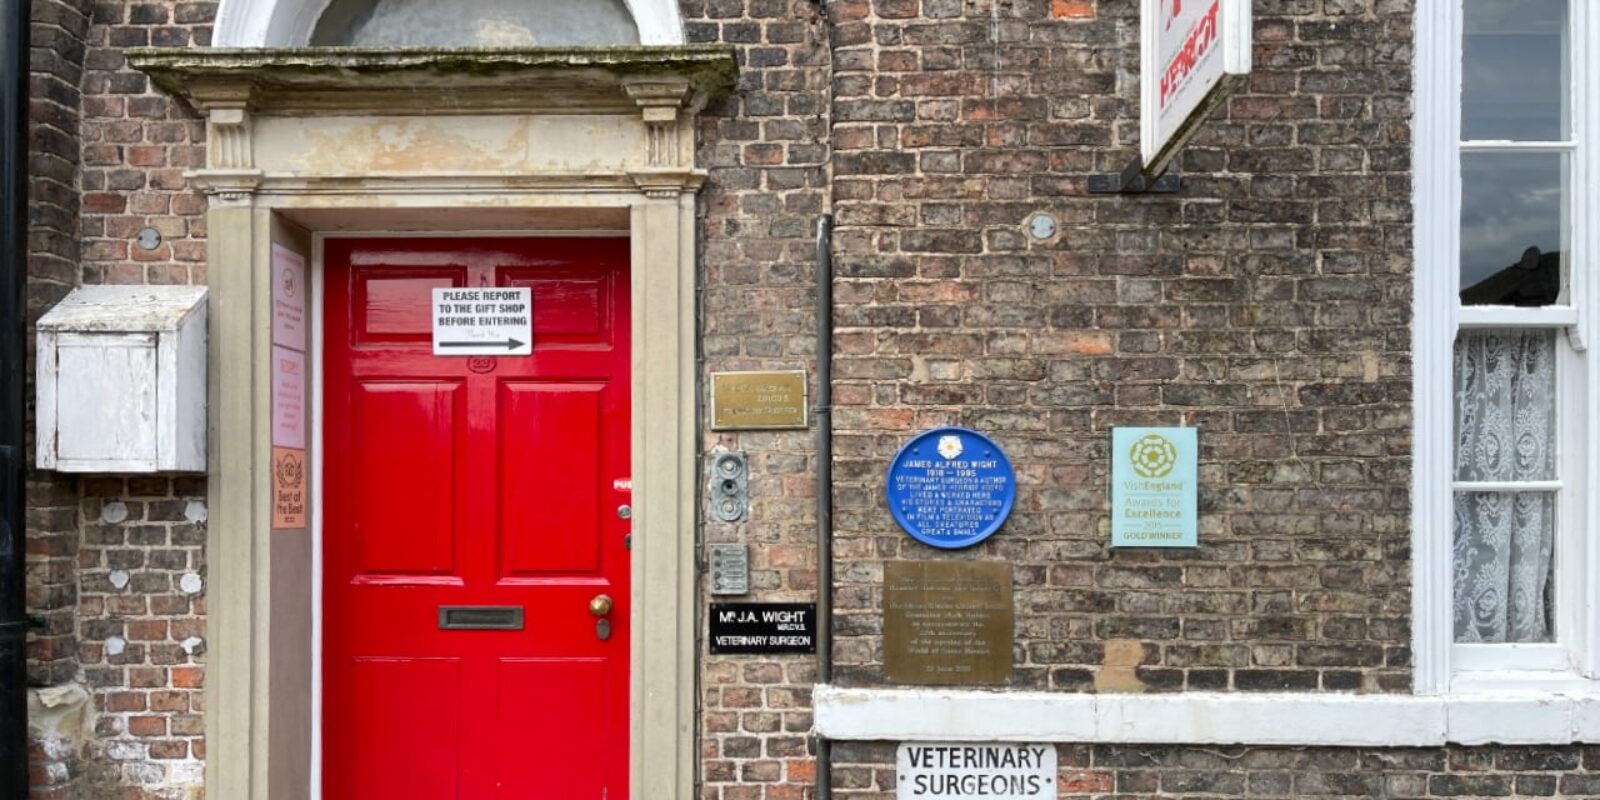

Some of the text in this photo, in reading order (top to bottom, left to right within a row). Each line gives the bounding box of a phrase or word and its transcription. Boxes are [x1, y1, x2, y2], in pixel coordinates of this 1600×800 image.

[442, 291, 520, 300] PLEASE REPORT
[439, 304, 525, 313] TO THE GIFT SHOP
[438, 317, 527, 326] BEFORE ENTERING
[896, 476, 939, 484] VETERINARY
[1124, 481, 1183, 491] VisitEngland
[1125, 498, 1181, 507] Awards for
[1125, 509, 1182, 518] Excellence
[1123, 532, 1183, 540] GOLD WINNER
[762, 611, 805, 622] WIGHT
[715, 635, 810, 646] VETERINARY SURGEON
[907, 747, 1045, 769] VETERINARY
[913, 774, 1040, 795] SURGEONS
